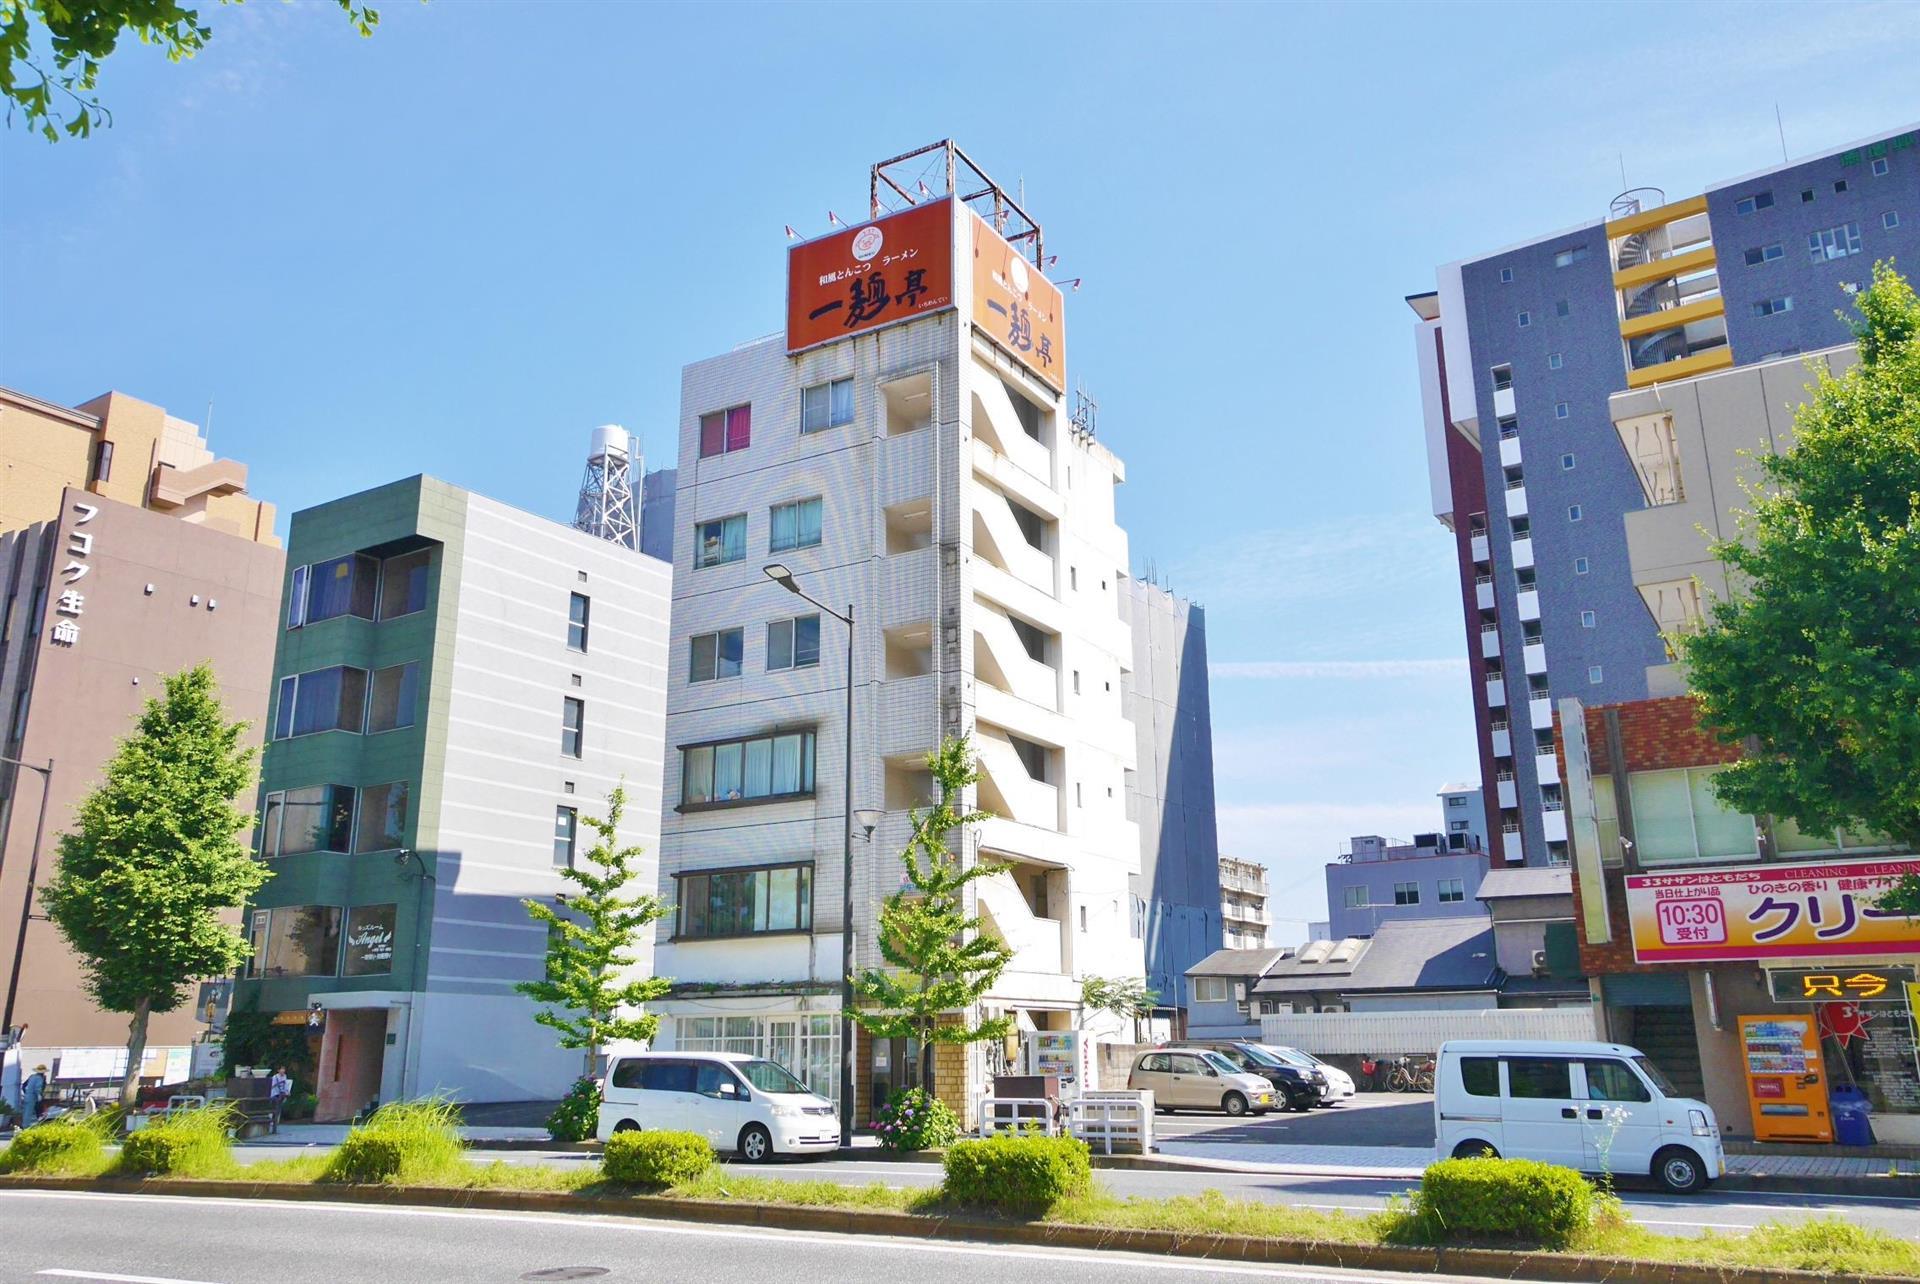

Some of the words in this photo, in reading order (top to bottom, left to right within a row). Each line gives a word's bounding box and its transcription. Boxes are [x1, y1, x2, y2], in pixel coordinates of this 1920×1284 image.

[882, 248, 919, 266] ラーメン
[52, 502, 98, 645] フコク生命
[1641, 872, 1761, 887] 33サザンはともだち
[1784, 867, 1848, 879] CLEANING
[1655, 887, 1721, 899] 当日仕上がり品
[1748, 880, 1828, 895] ひのきの香り
[1661, 904, 1720, 927] 10:30
[356, 931, 384, 949] Angel
[1676, 927, 1709, 941] 受付
[1803, 973, 1888, 997] 只今
